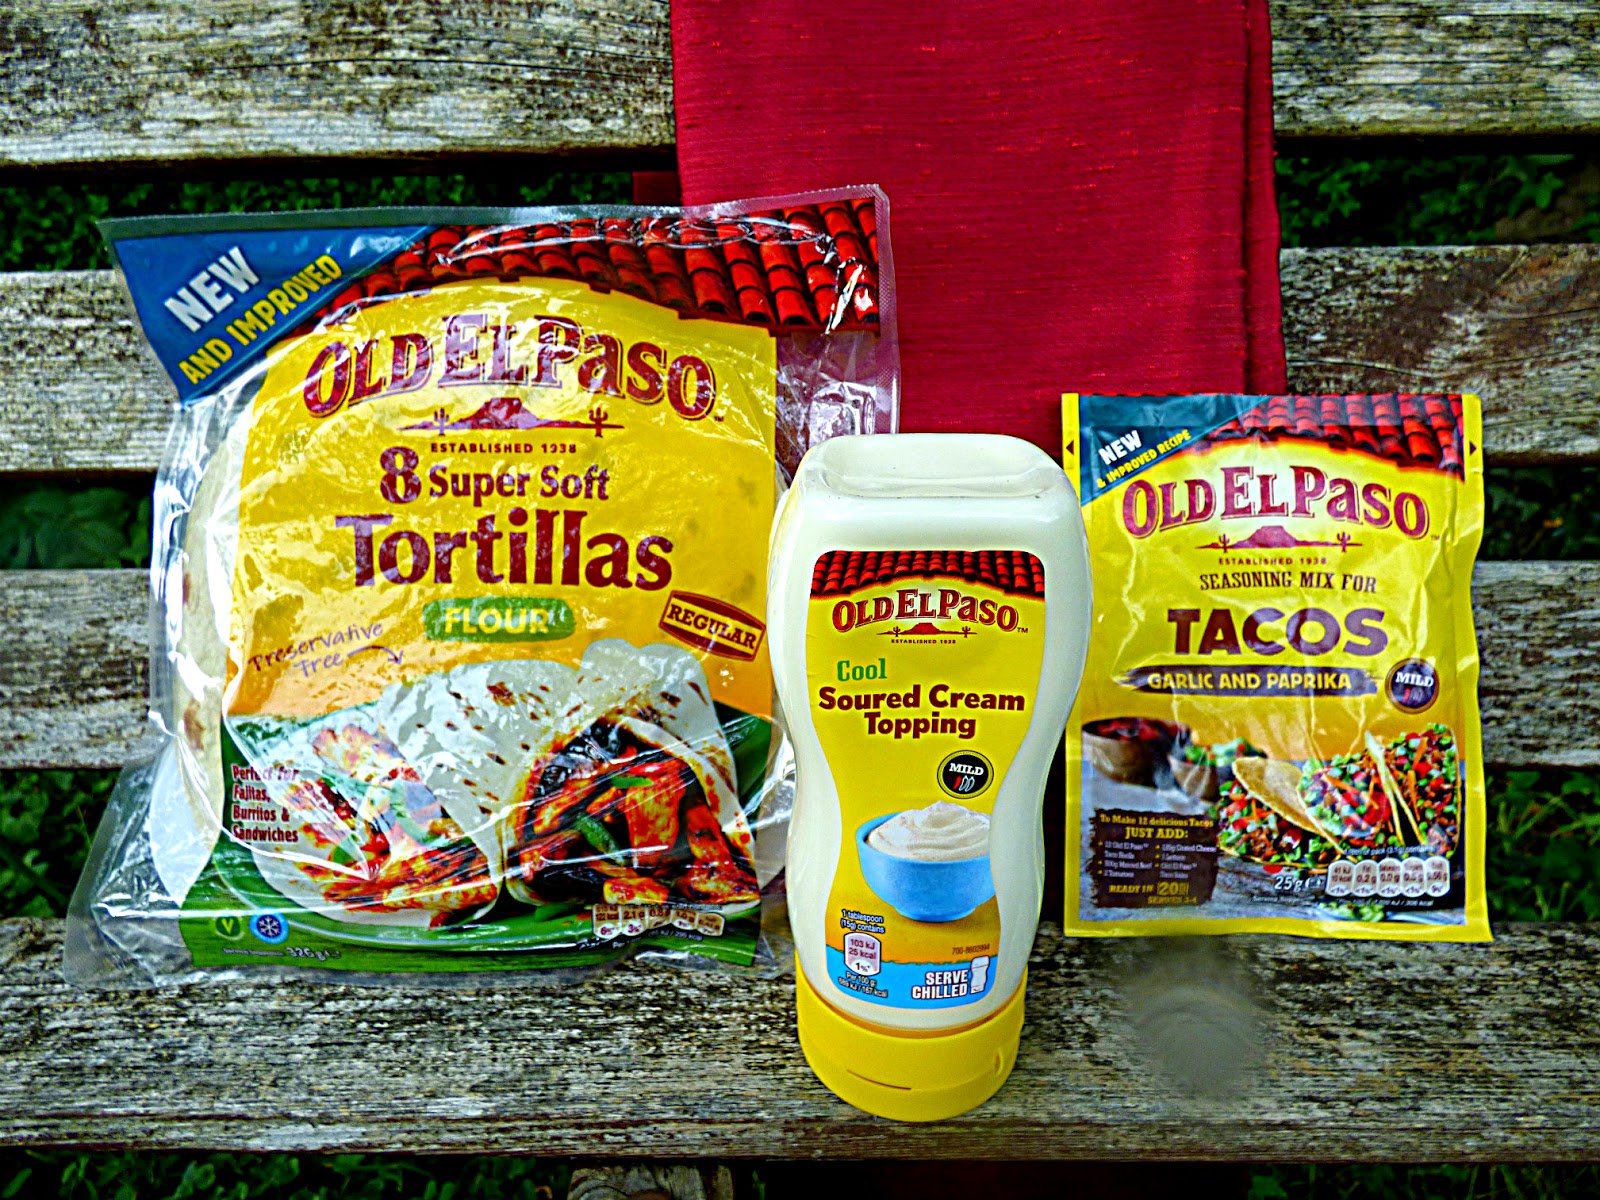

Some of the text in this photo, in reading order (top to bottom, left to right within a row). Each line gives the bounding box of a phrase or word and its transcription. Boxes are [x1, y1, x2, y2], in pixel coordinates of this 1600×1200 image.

[165, 246, 260, 333] NEW
[177, 254, 343, 385] AND IMPROVED
[303, 331, 433, 418] OLD
[430, 442, 577, 454] ESTABLISHED 1938
[1096, 429, 1191, 489] & IMPROVED RECIPE
[1098, 430, 1142, 465] NEW
[379, 446, 610, 507] 8 Super Soft
[1122, 479, 1217, 540] OLD
[1219, 466, 1289, 520] EL
[335, 507, 673, 592] Tortillas
[1218, 557, 1294, 566] ESTABLISHED
[1200, 571, 1377, 594] SEASONING MIX FOR
[444, 607, 550, 635] FLOUR
[832, 596, 894, 633] OLD
[895, 588, 937, 620] EL
[667, 603, 757, 650] REGULAR
[1167, 607, 1389, 657] TACOS
[247, 622, 384, 671] Preservative
[293, 652, 345, 678] Free
[837, 658, 887, 682] Cool
[1148, 671, 1352, 690] GARLIC AND PAPRIKA
[1395, 671, 1434, 689] MILD
[819, 684, 1025, 712] Soured Cream
[864, 711, 976, 740] Topping
[949, 762, 984, 776] MILD
[233, 804, 290, 822] Burritos &
[1100, 814, 1110, 823] To
[1112, 815, 1136, 825] Make
[1150, 817, 1188, 827] delicious
[1189, 818, 1214, 828] Tacos
[233, 825, 299, 842] Sandwiches
[1125, 827, 1189, 839] JUST ADD:
[1109, 885, 1140, 893] READY
[1159, 882, 1178, 895] 20
[847, 910, 883, 923] tablespoon
[857, 924, 885, 934] contains
[848, 948, 877, 960] 25 kcal
[850, 939, 876, 950] 103 kJ
[925, 970, 968, 986] SERVE
[912, 984, 968, 1000] CHILLED
